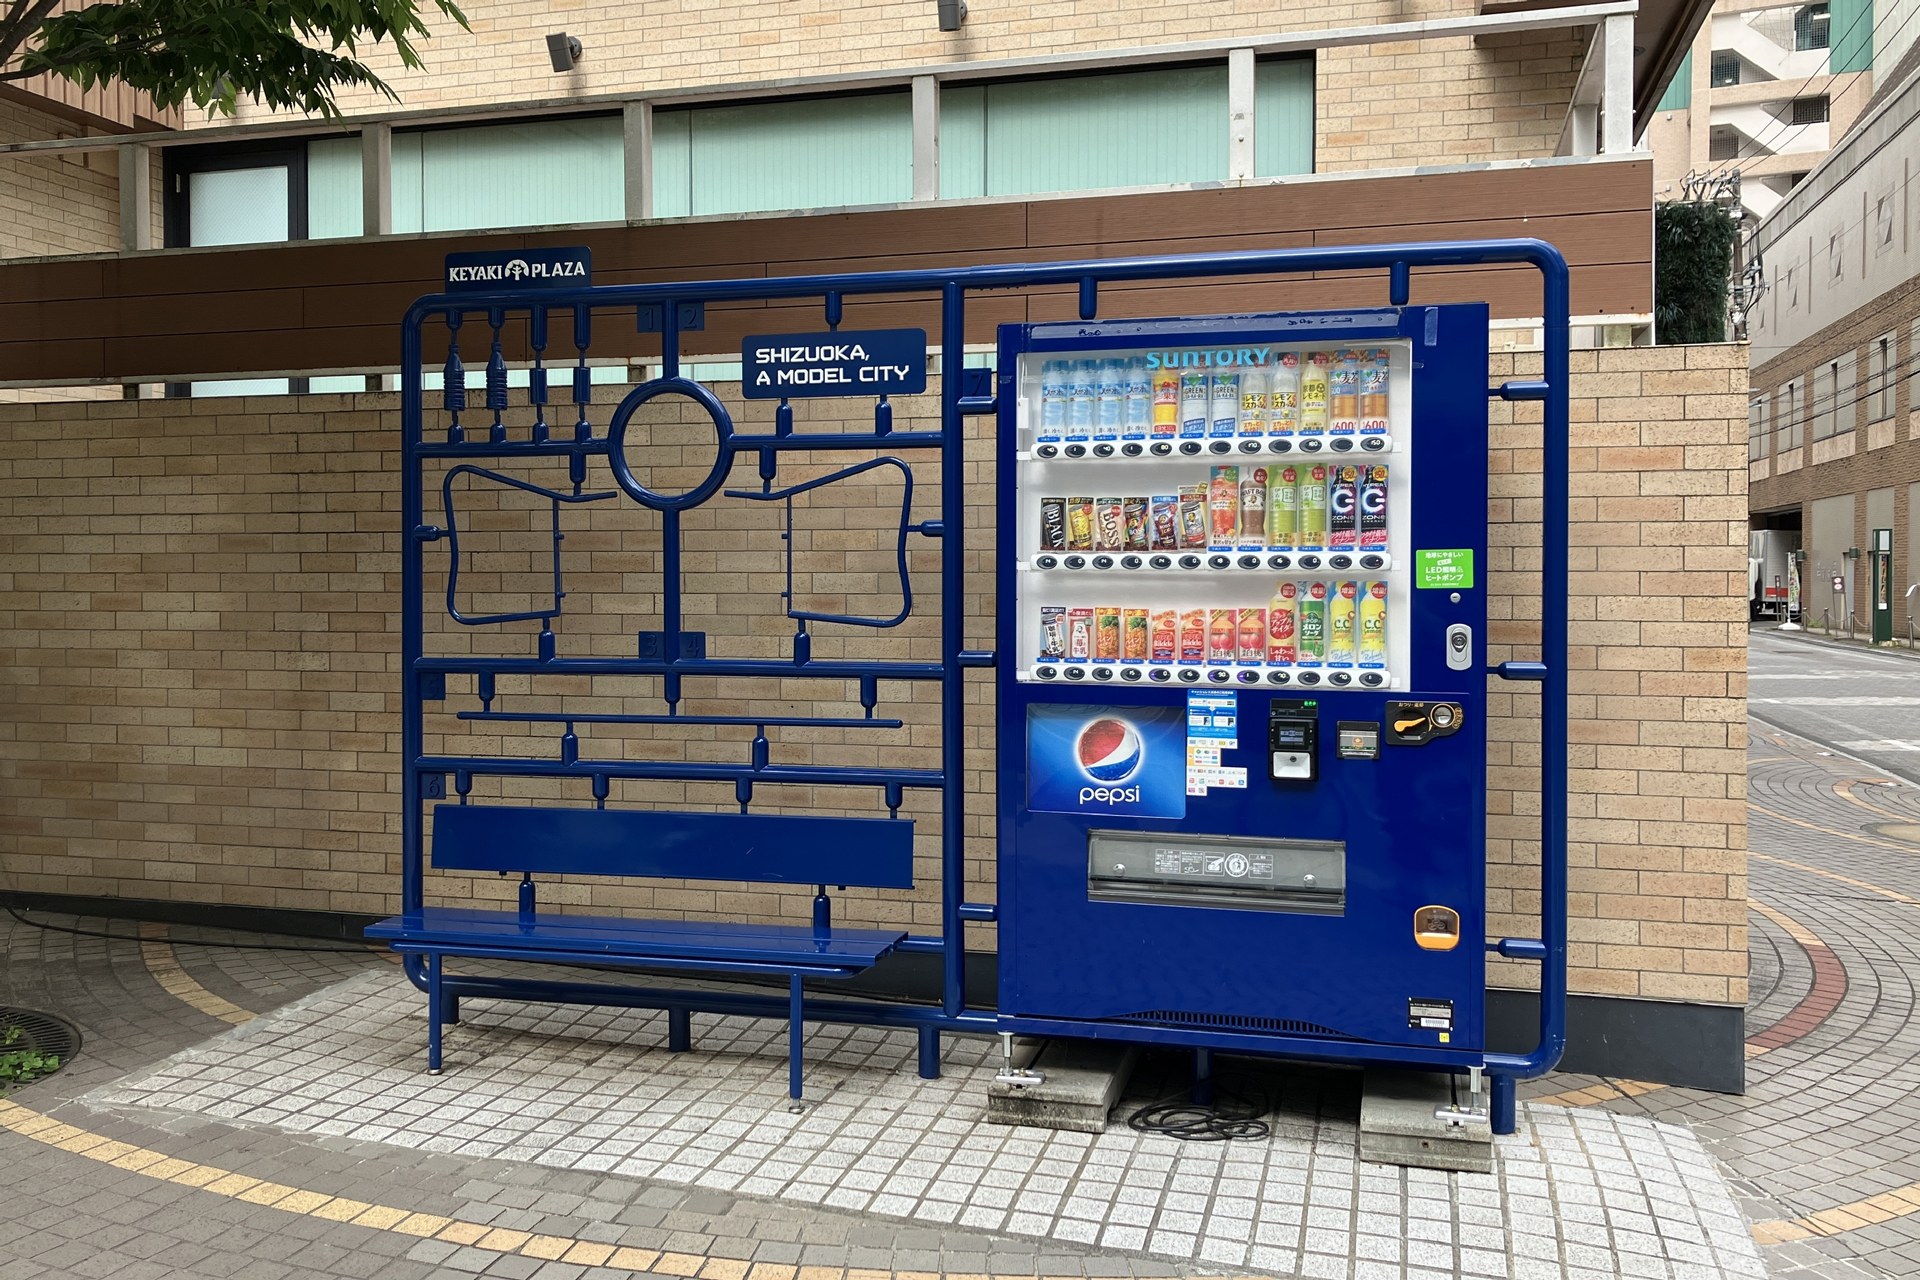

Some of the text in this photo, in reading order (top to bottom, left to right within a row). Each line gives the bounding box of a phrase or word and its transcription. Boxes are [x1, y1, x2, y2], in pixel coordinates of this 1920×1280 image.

[449, 261, 586, 281] KEYAKI PLAZA
[645, 308, 654, 330] 1
[684, 308, 698, 329] 2
[755, 345, 870, 364] SHIZUOKA,
[756, 364, 910, 386] A MODEL CITY
[1303, 392, 1327, 400] レモネード
[1047, 510, 1065, 548] BLACK
[1103, 512, 1120, 547] BOSS
[645, 634, 657, 656] 3
[686, 634, 700, 657] 4
[429, 776, 441, 797] 6
[1079, 784, 1140, 805] pepsi
